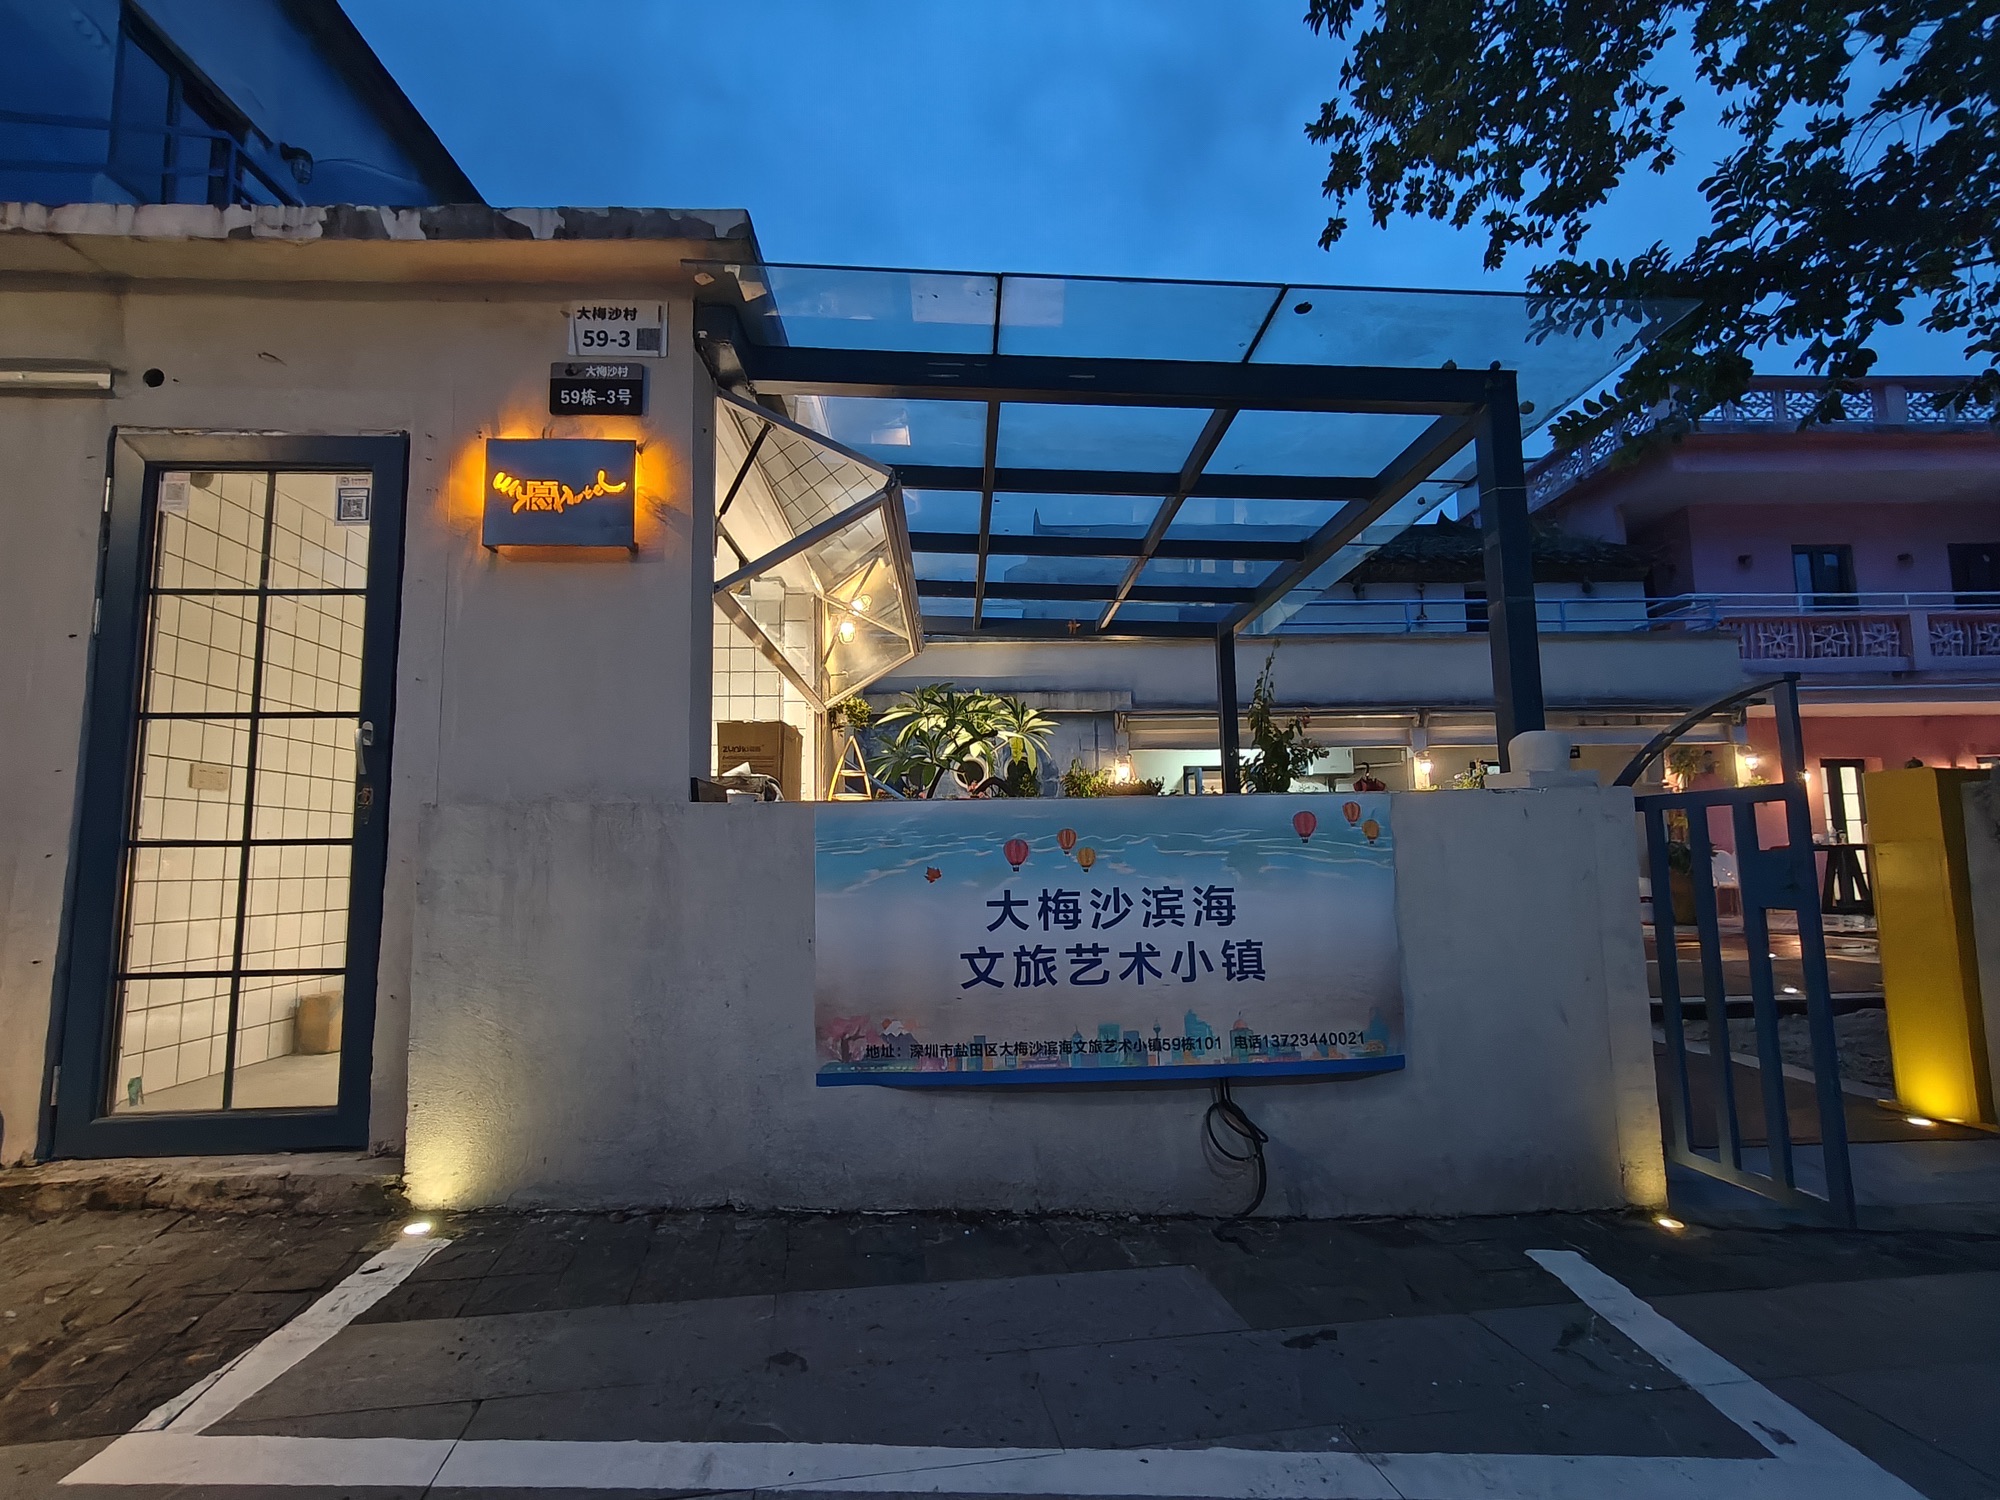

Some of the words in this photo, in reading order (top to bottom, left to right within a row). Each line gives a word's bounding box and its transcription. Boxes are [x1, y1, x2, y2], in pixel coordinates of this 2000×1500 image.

[577, 306, 637, 321] 大梅沙村
[583, 330, 630, 348] 59-3
[586, 365, 629, 378] 大梅沙村
[561, 388, 632, 406] 59栋-3号
[986, 884, 1238, 933] 大梅沙滨海
[959, 938, 1267, 990] 文旅艺术小镇
[1234, 1031, 1366, 1050] 电话13723440021
